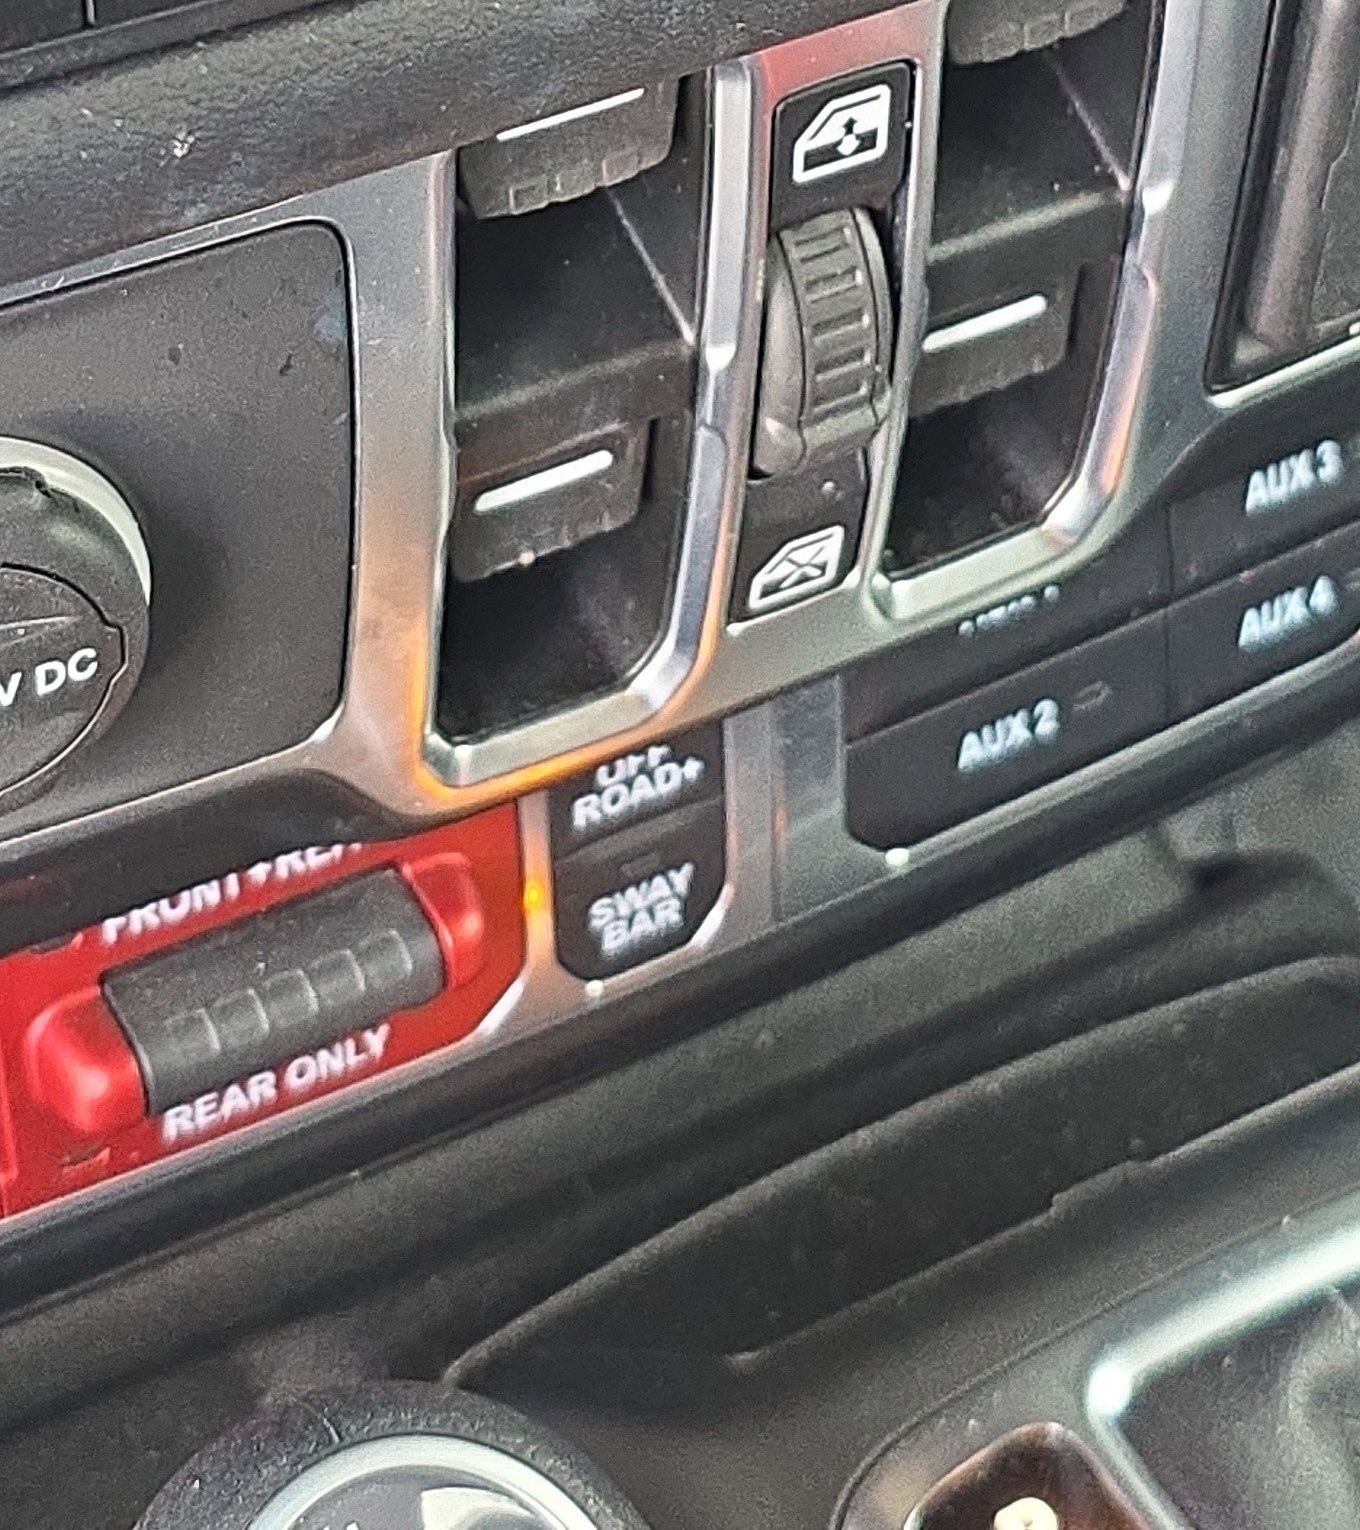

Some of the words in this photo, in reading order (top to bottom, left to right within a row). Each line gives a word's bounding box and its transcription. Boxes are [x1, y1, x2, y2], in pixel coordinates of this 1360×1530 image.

[1245, 449, 1317, 514] AUX
[1316, 439, 1343, 485] 3
[1238, 586, 1310, 648] AUX
[1309, 575, 1338, 614] 4
[34, 647, 98, 697] DC
[957, 709, 1032, 772] AUX
[1033, 699, 1060, 740] 2
[589, 862, 694, 929] SWAY
[602, 899, 684, 954] BAR
[162, 1080, 278, 1144] REAR
[286, 1024, 393, 1088] ONLY
